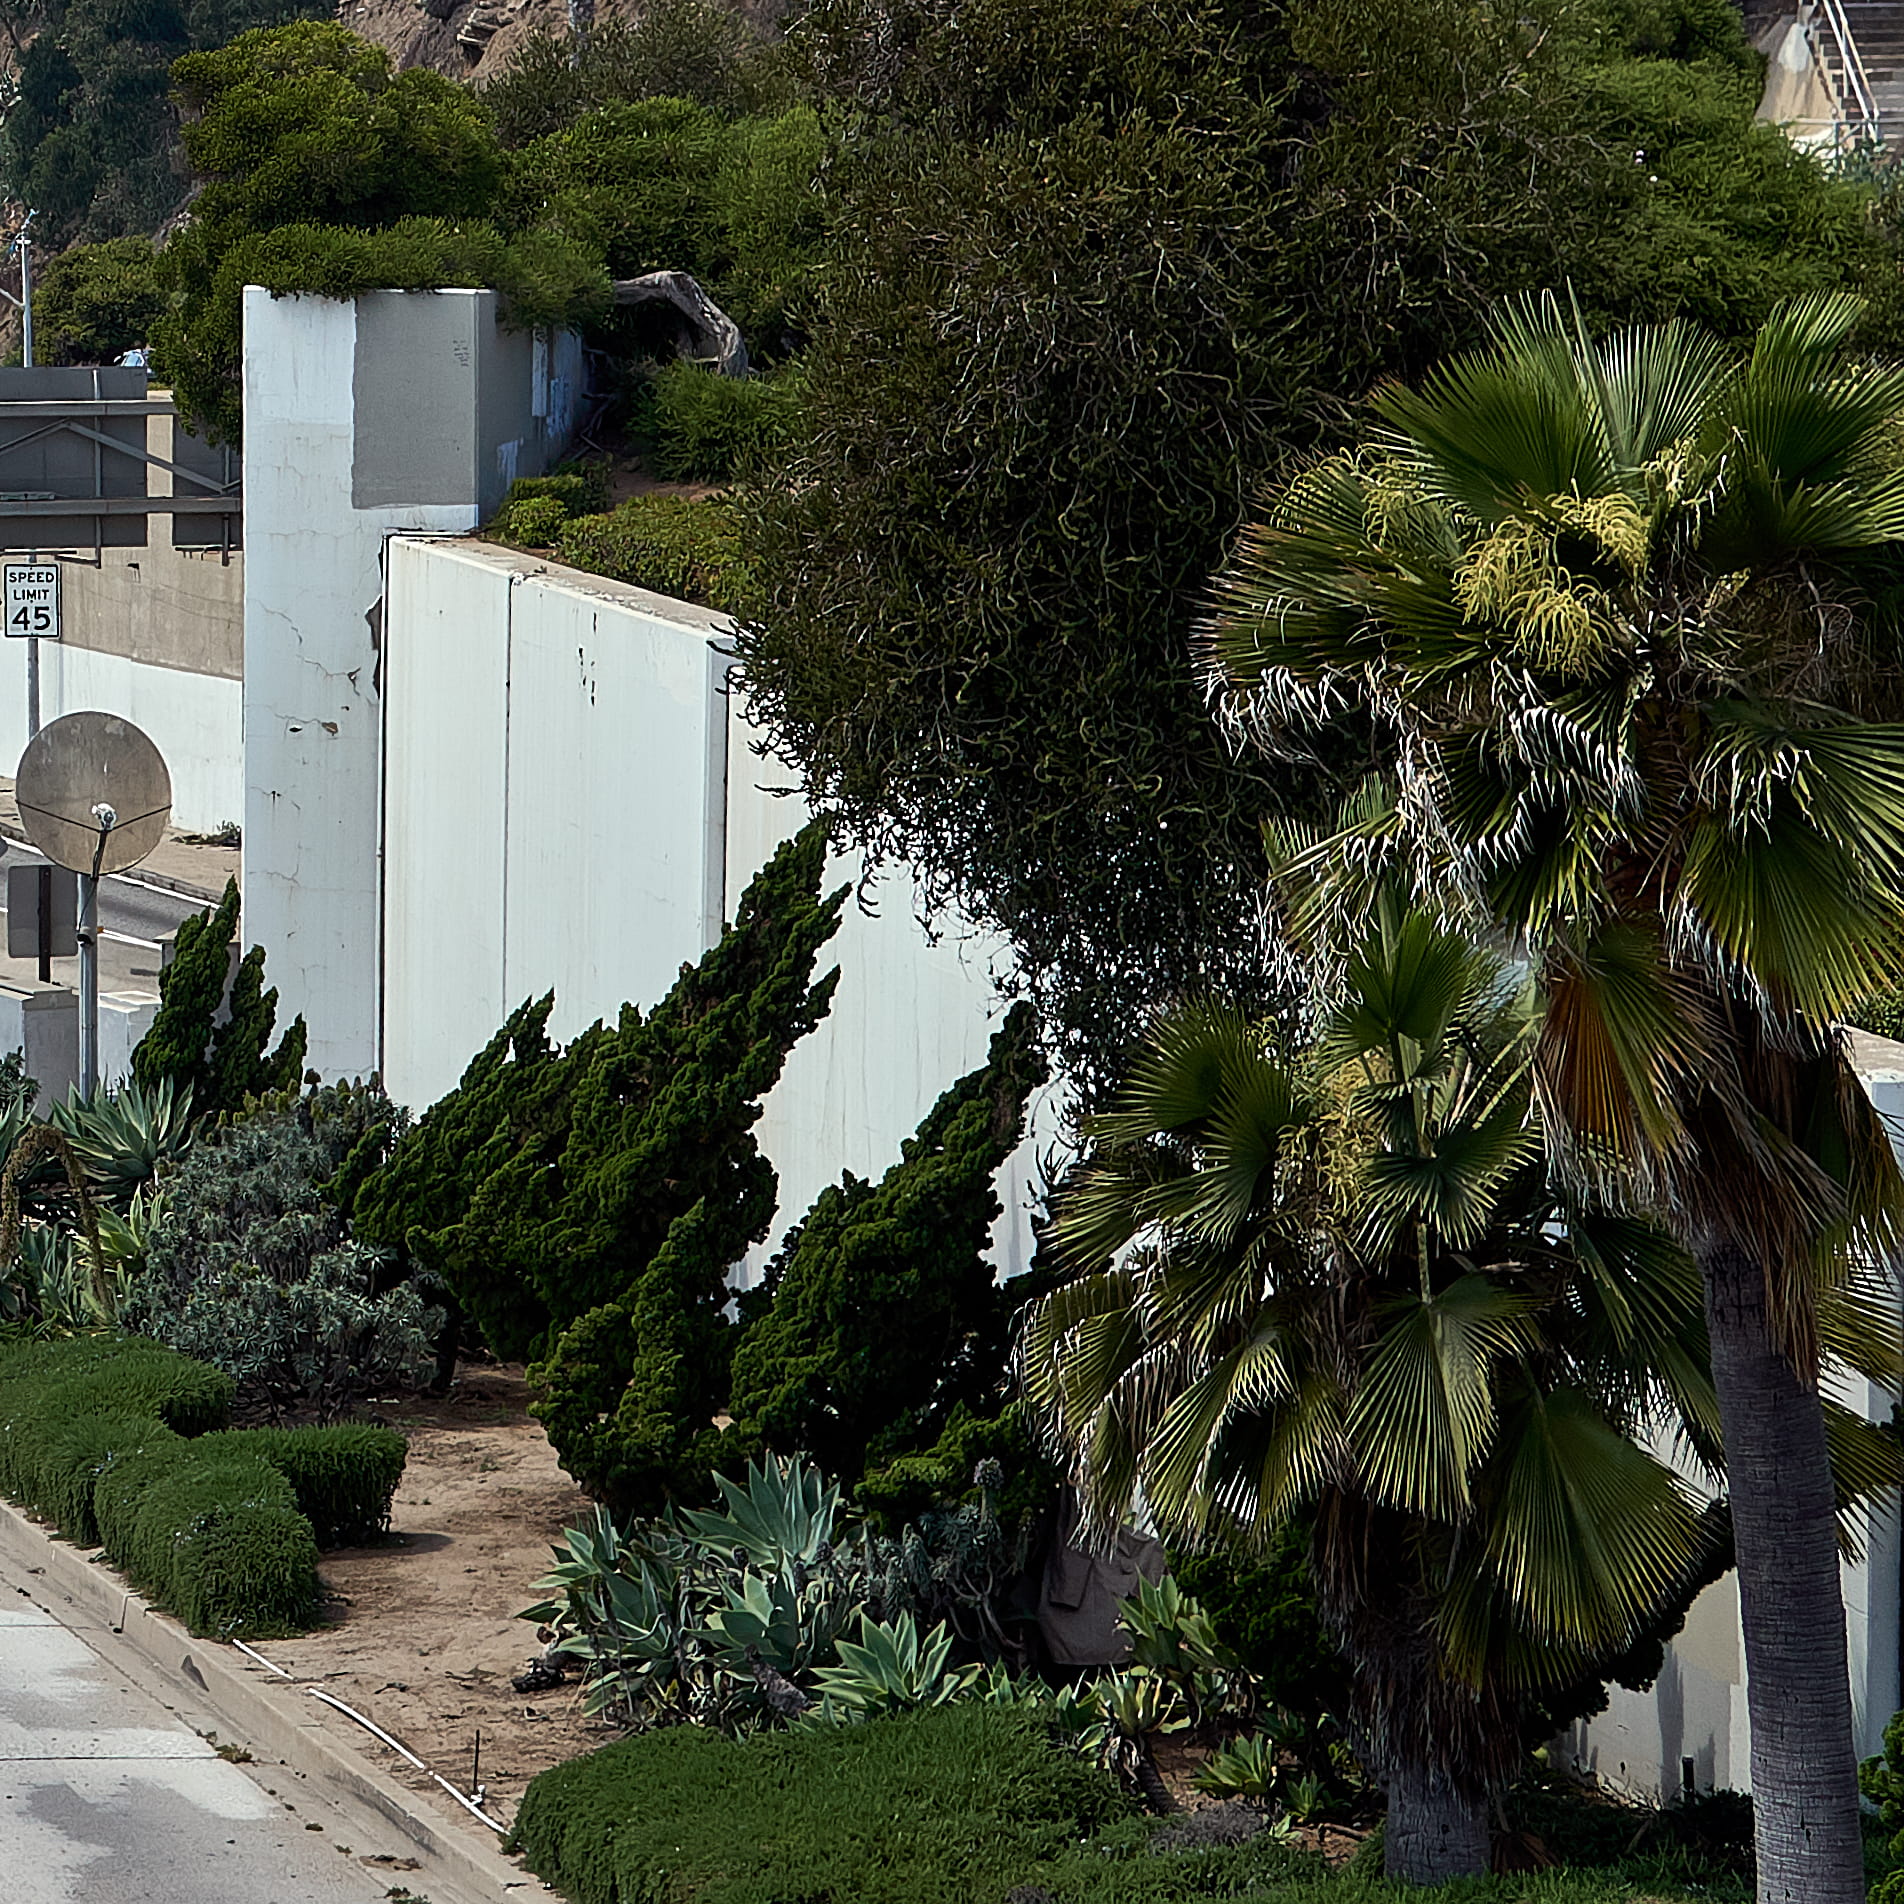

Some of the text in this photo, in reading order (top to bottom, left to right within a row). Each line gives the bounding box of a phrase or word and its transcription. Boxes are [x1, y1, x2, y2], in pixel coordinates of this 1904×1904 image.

[8, 571, 55, 583] SPEED
[13, 588, 50, 601] LIMIT
[11, 606, 51, 631] 45
